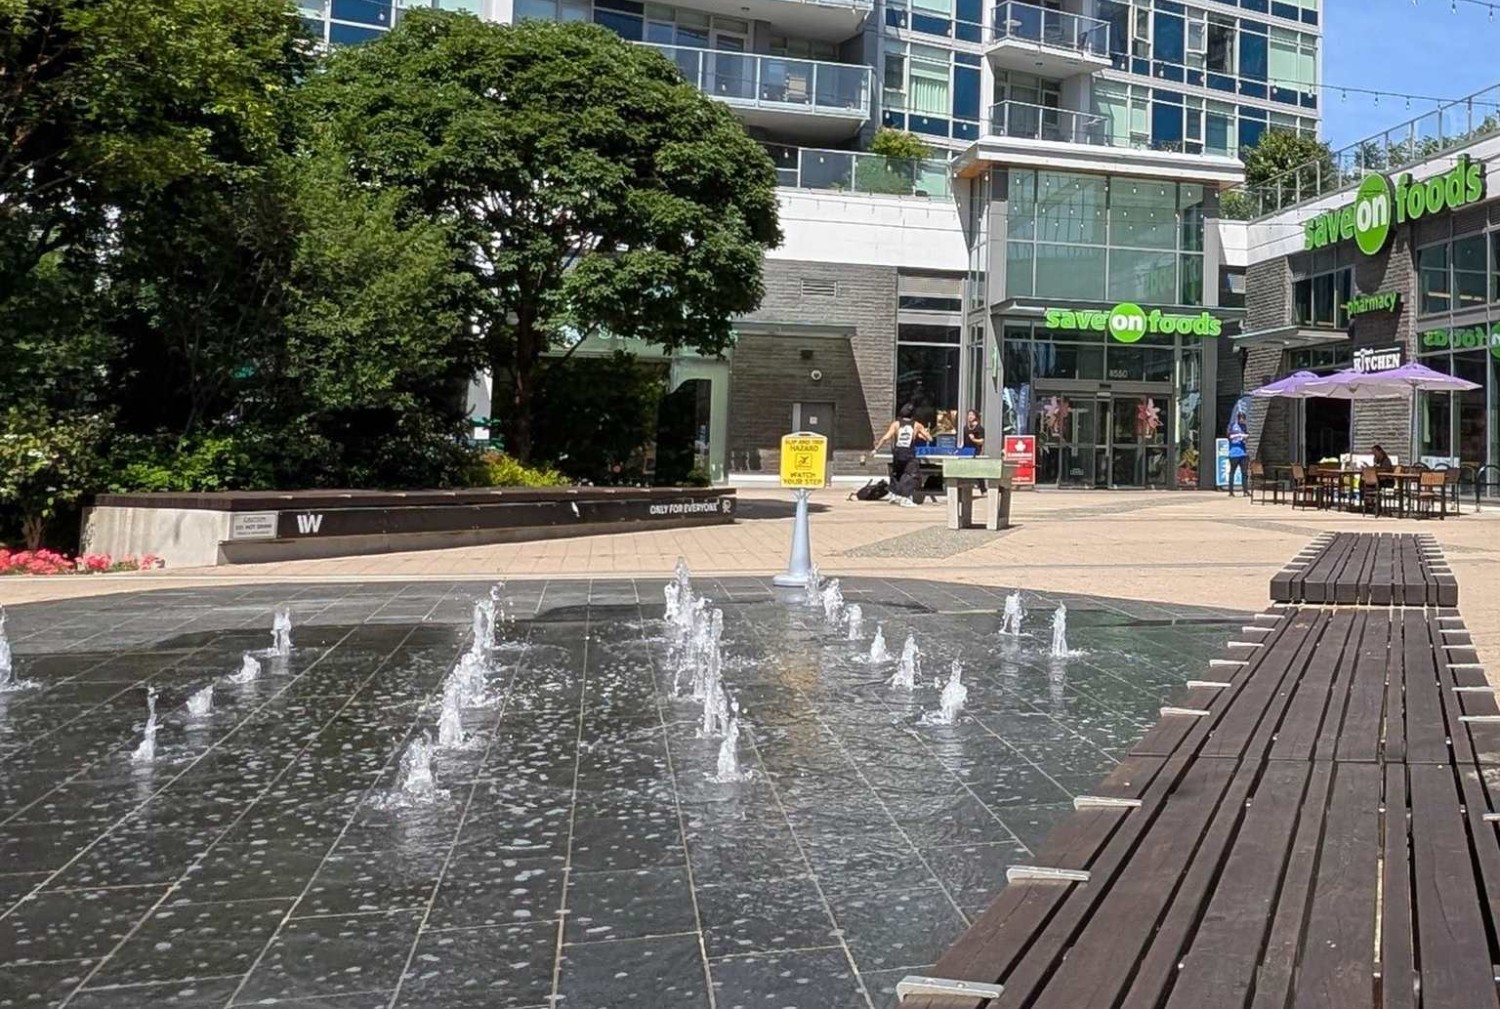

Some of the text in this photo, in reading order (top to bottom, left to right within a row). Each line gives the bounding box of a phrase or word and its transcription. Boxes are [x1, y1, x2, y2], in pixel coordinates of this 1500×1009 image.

[1304, 154, 1486, 251] save on foods
[1347, 292, 1398, 320] pharmacy
[1045, 308, 1223, 337] save on foods
[1353, 352, 1401, 372] KITCHEN
[650, 504, 669, 514] ONLY
[669, 503, 682, 513] FOR
